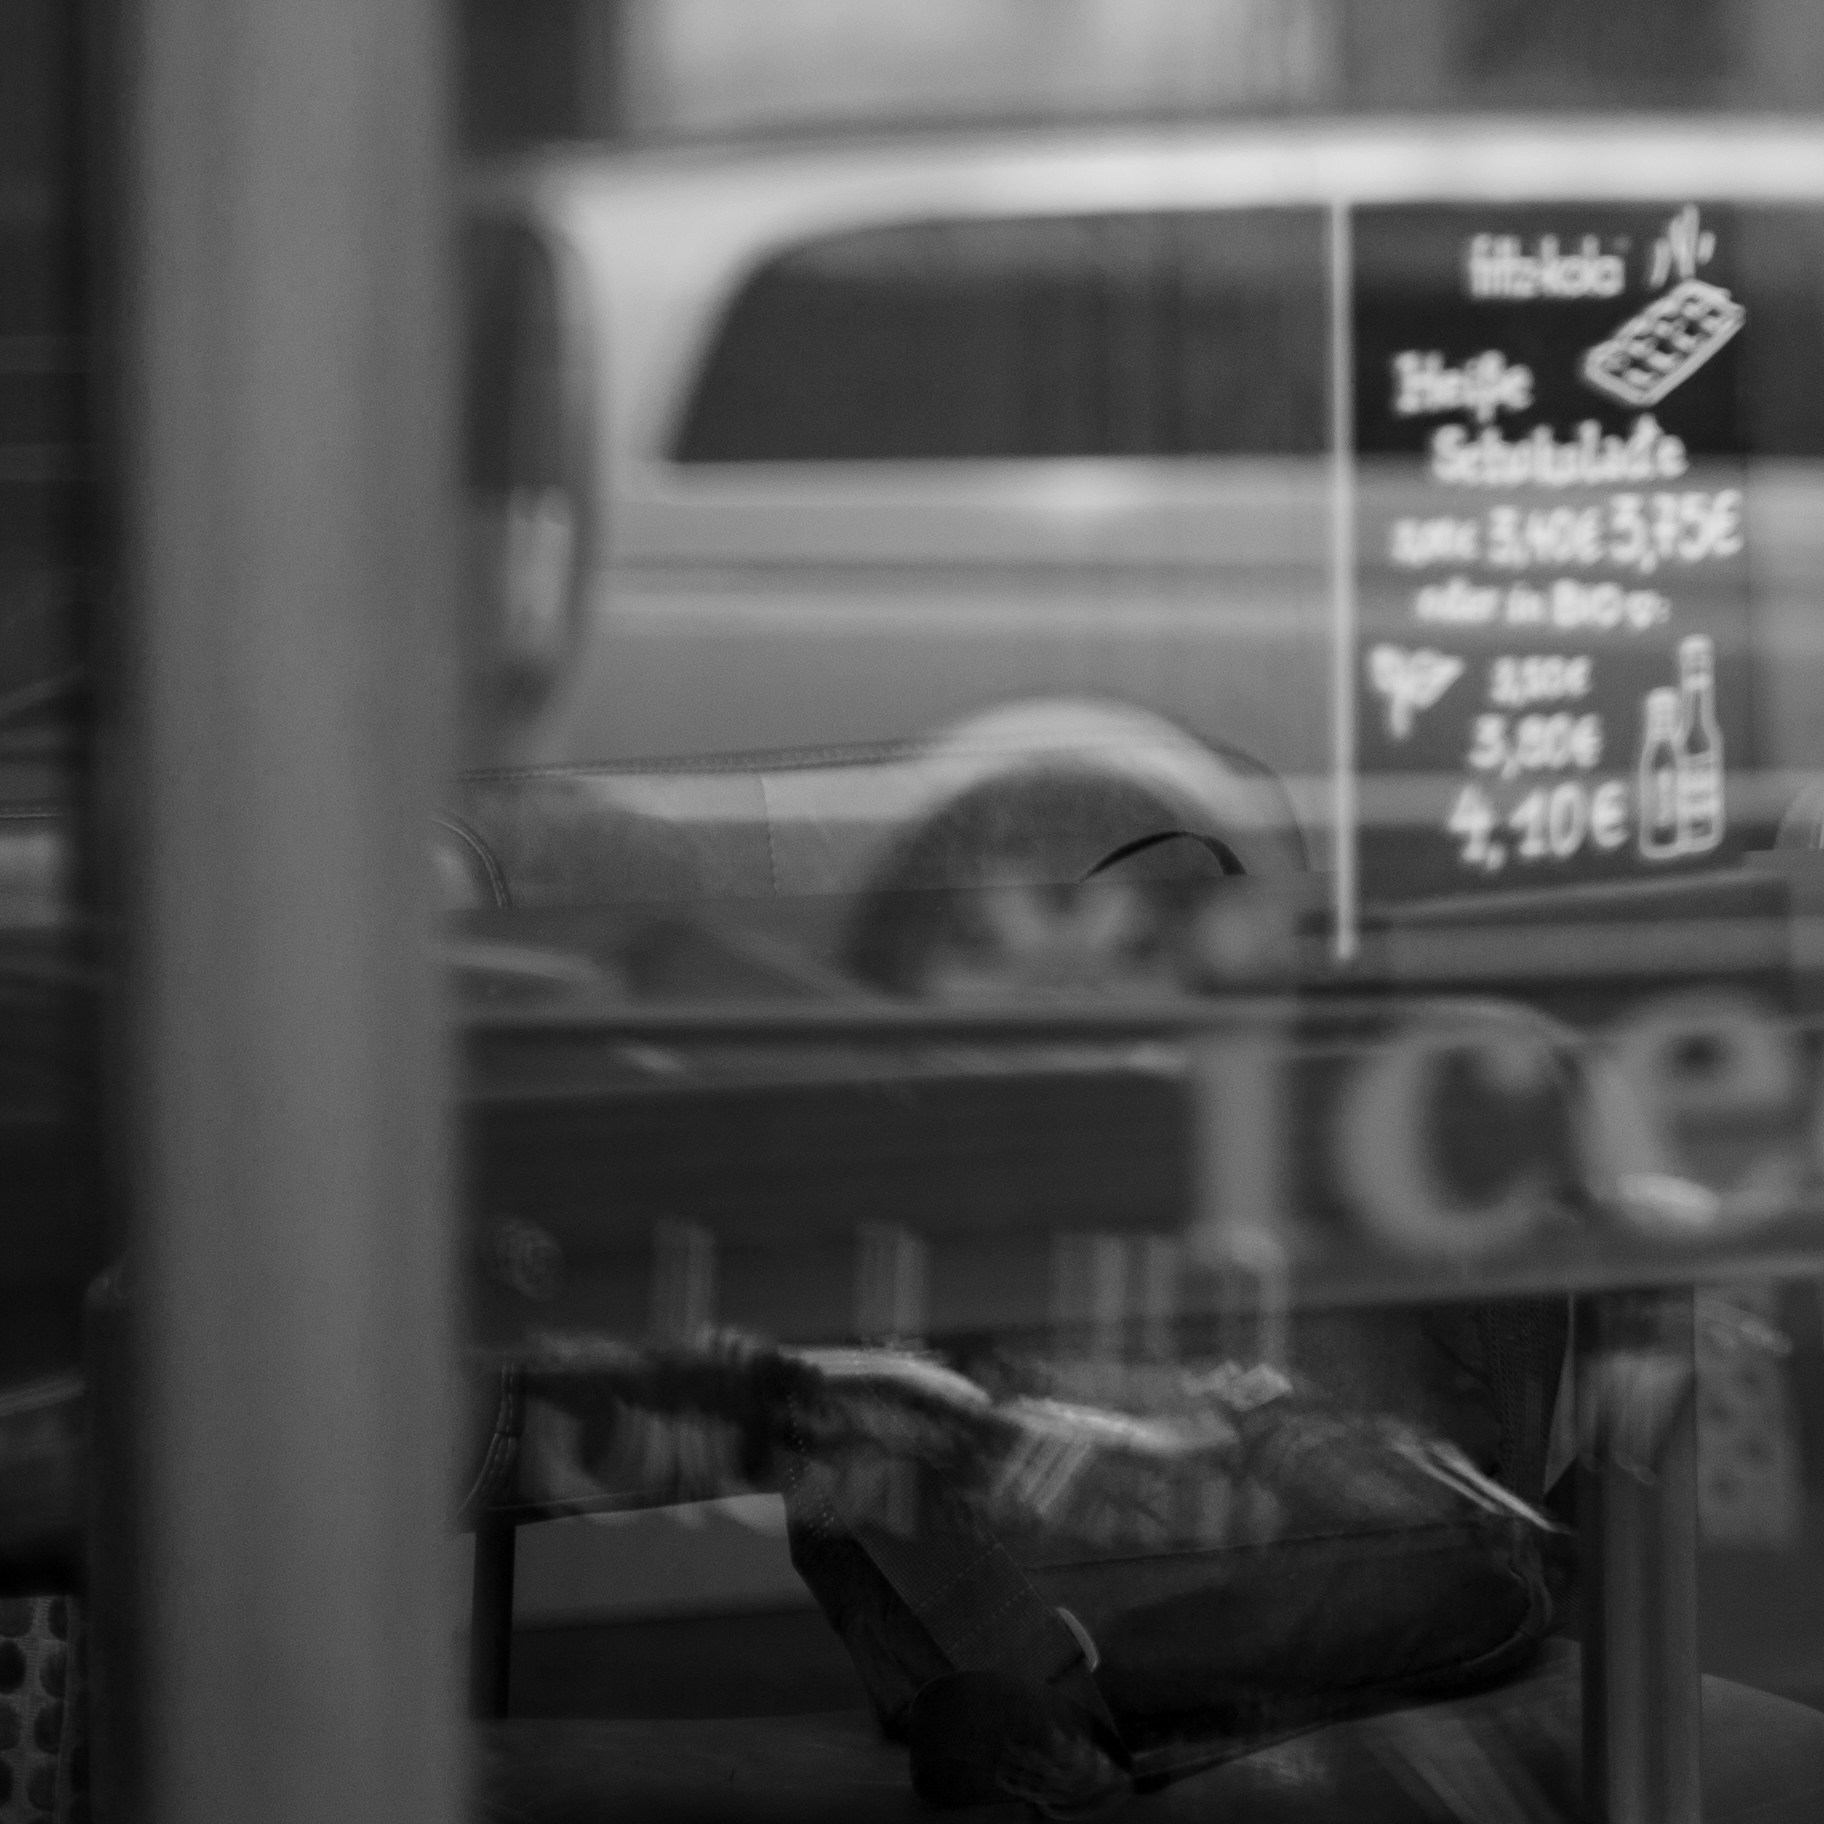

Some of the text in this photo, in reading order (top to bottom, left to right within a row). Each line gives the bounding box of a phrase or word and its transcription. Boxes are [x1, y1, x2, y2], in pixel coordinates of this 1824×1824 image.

[1431, 413, 1689, 486] Schokolade
[1609, 489, 1743, 573] 3,75€
[1447, 780, 1631, 869] 4,10€
